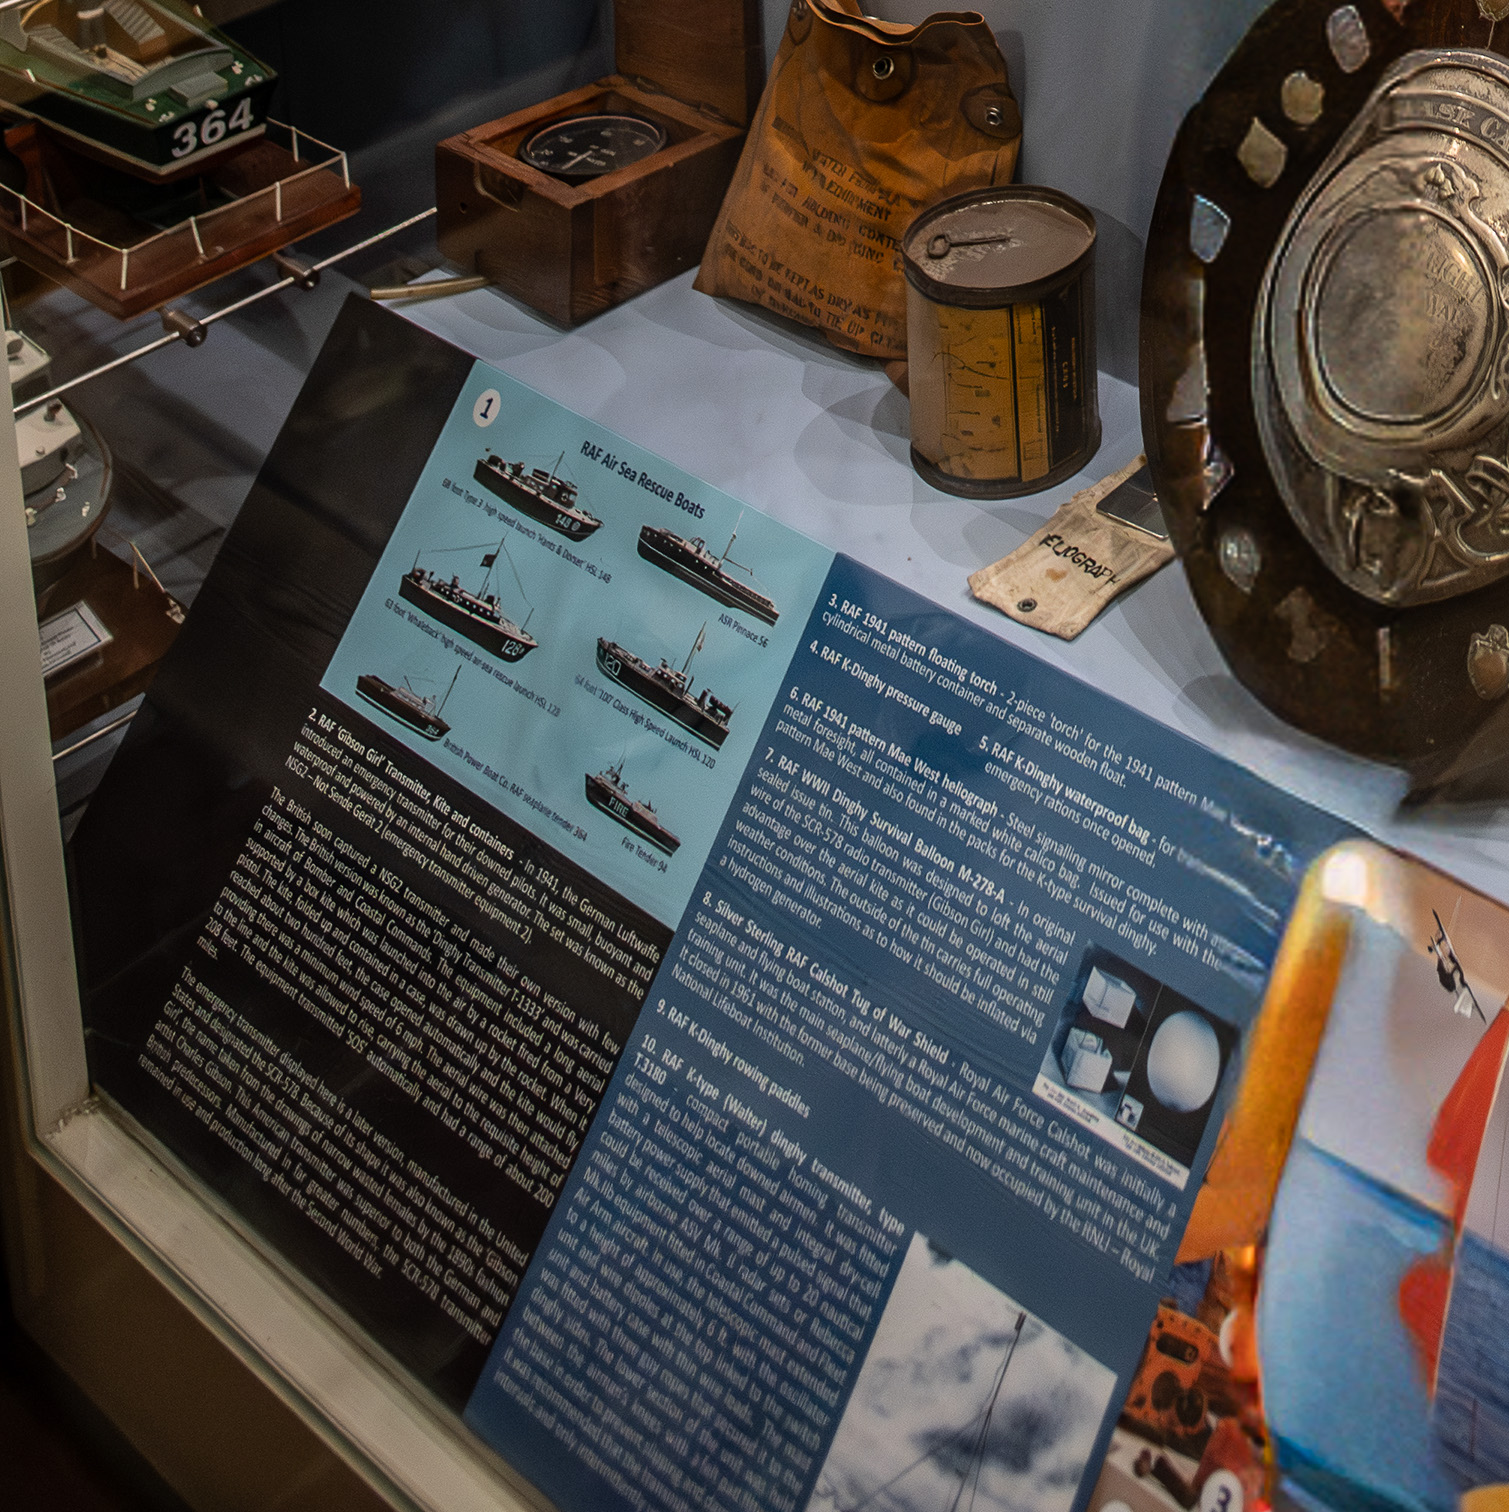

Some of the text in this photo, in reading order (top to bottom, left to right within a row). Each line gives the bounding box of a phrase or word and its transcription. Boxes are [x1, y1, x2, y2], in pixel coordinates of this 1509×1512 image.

[171, 97, 255, 159] 364
[480, 397, 494, 420] 1
[579, 440, 706, 520] RAF Air Sea Rescue Boats
[828, 593, 998, 696] 3. RAF 1941 pattern floating torch
[307, 707, 318, 722] 2.
[317, 713, 337, 733] RAF
[384, 759, 432, 805] Transmitter,
[432, 794, 451, 816] Kite
[450, 810, 471, 829] and
[468, 822, 515, 861] containers
[524, 859, 535, 875] In
[535, 867, 559, 895] 1941,
[561, 886, 579, 906] the
[579, 897, 616, 933] German
[616, 923, 660, 963] Luftwaffe
[608, 795, 630, 818] FIRE
[620, 836, 668, 874] Fire Tender 94
[764, 746, 775, 763] 7.
[777, 754, 801, 776] RAF
[831, 787, 869, 822] Dinghy
[869, 811, 914, 847] Survival
[914, 837, 955, 873] Balloon
[957, 864, 1005, 904] M-278-A
[270, 785, 620, 1055] The British soon captured a NSG2 transmitter and made their own version with few
[702, 890, 950, 1065] 8. Silver Sterling RAF Calshot Tug of War Shield
[641, 1033, 657, 1055] 10.
[661, 1048, 685, 1072] RAF
[685, 1066, 720, 1101] K-type
[770, 1128, 808, 1167] dinghy
[878, 1206, 905, 1236] type
